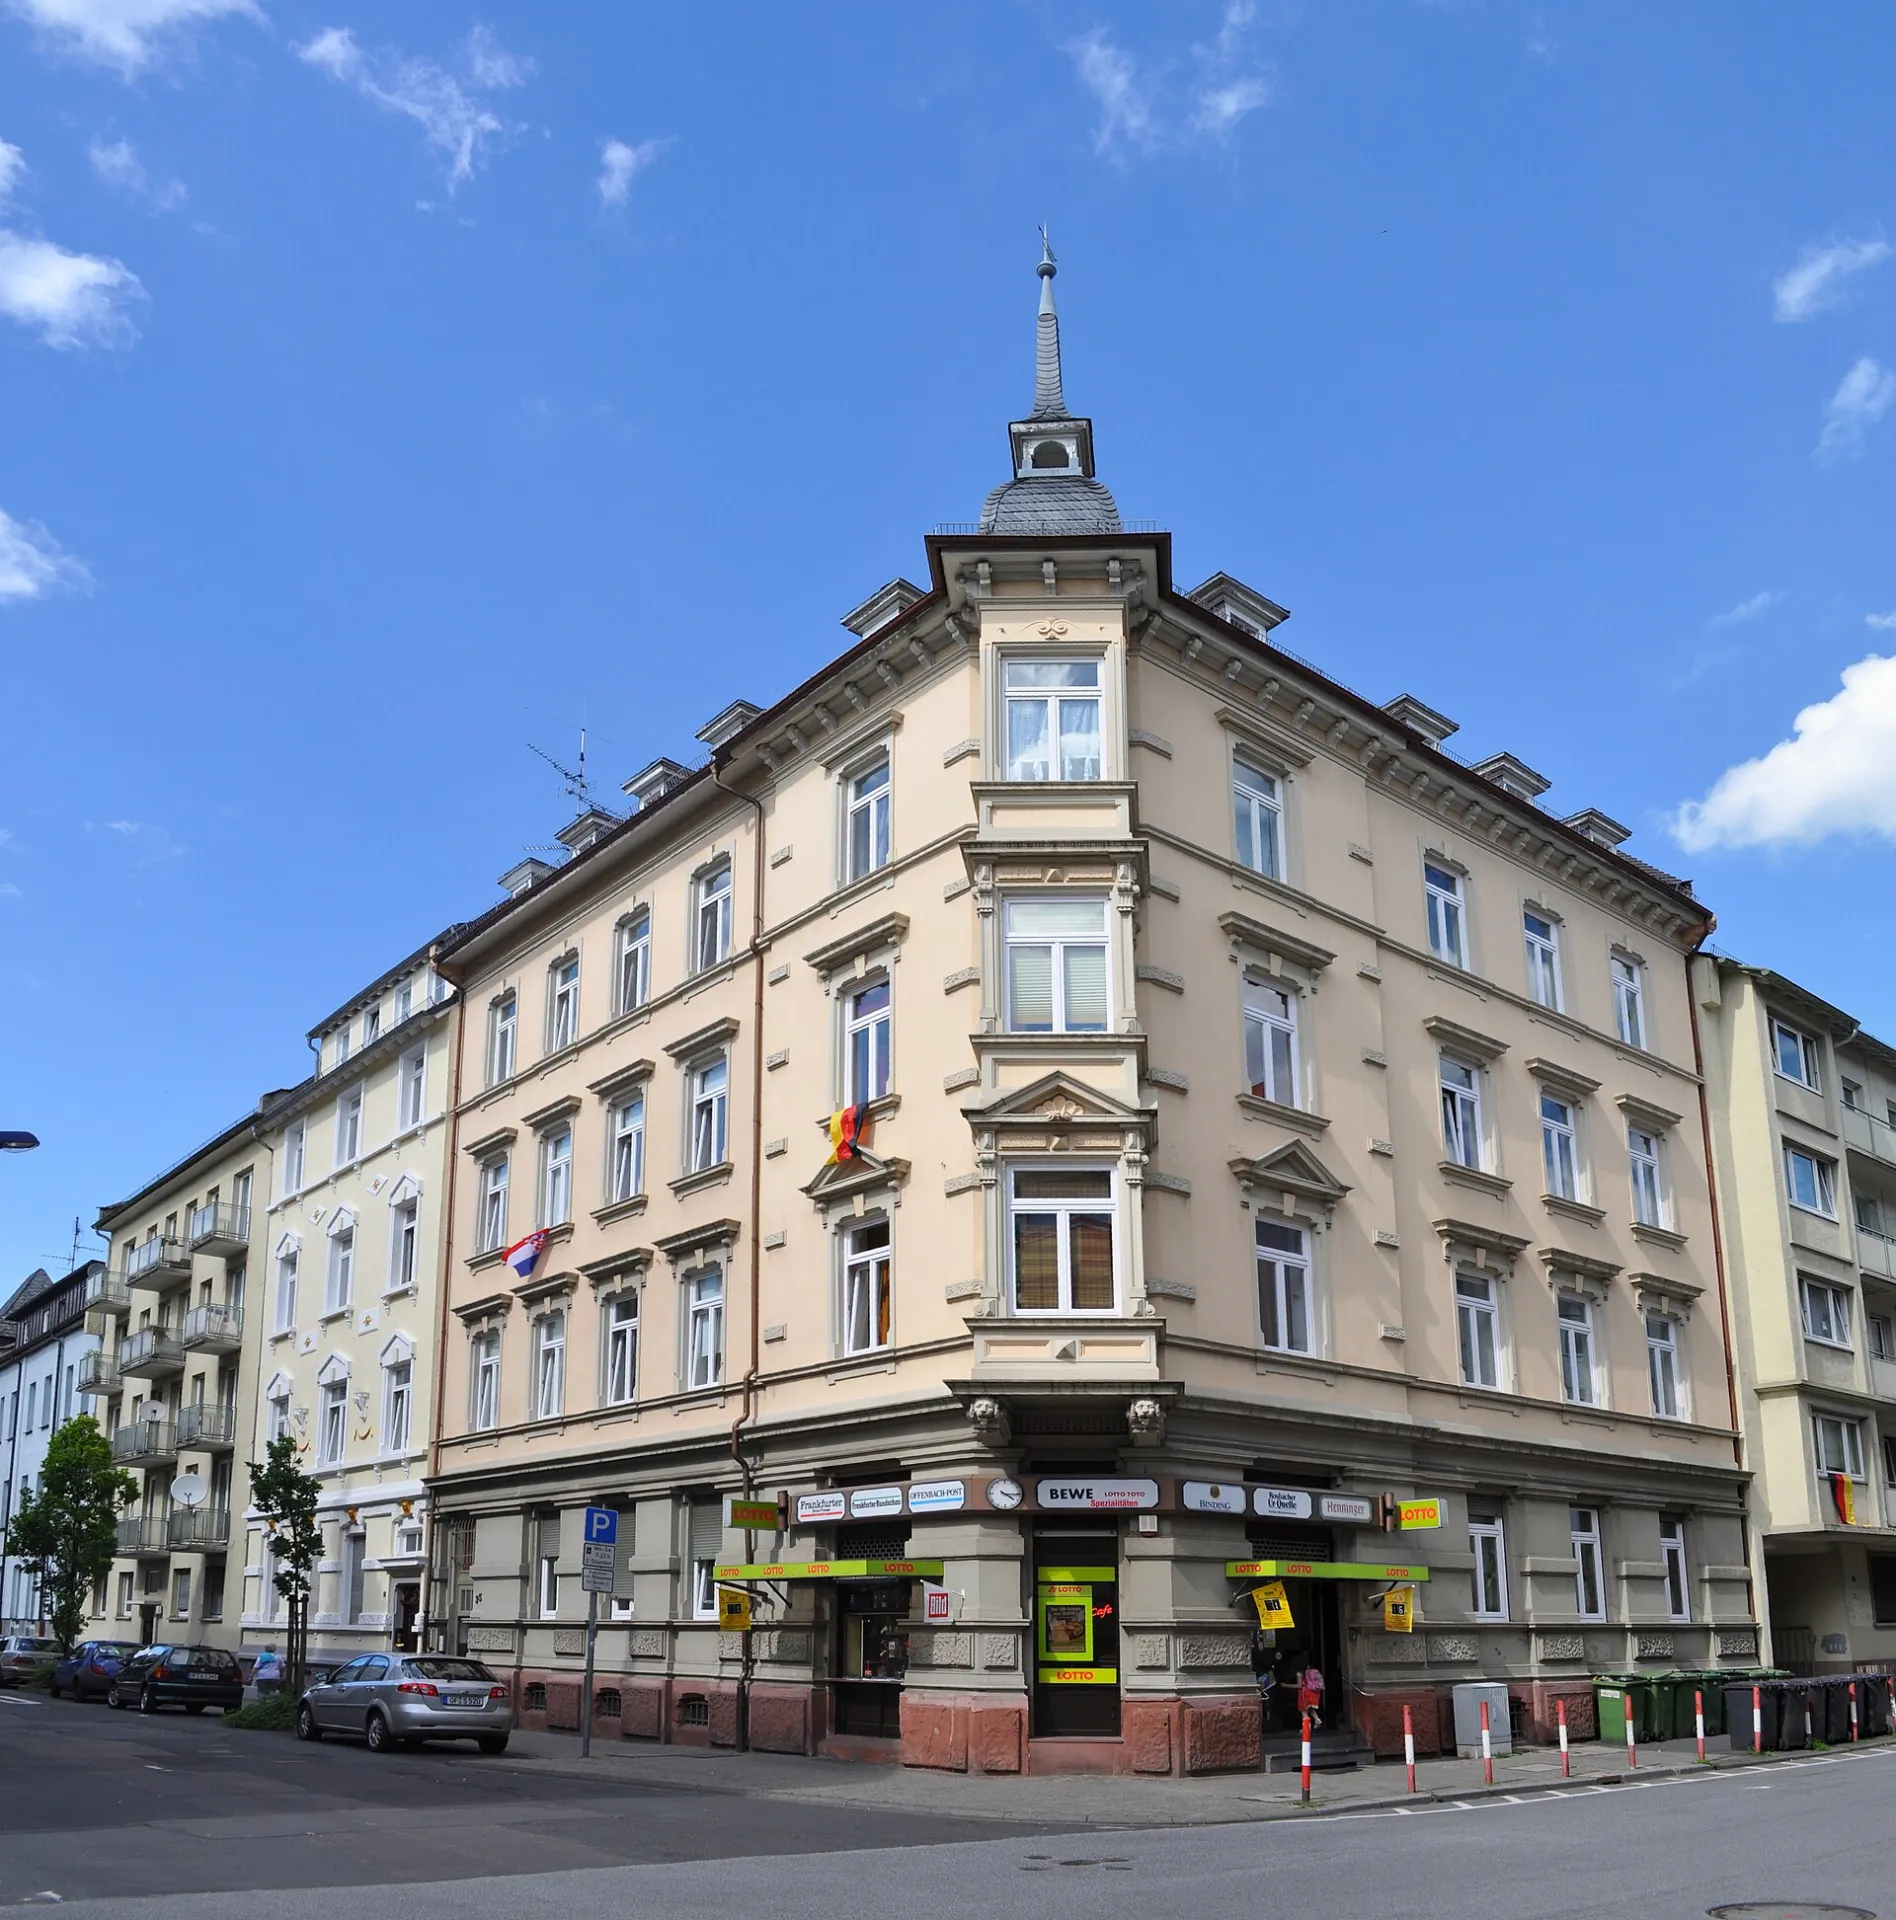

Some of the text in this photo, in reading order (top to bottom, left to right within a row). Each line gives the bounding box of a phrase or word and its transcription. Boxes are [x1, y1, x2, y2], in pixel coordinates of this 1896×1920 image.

[910, 1487, 963, 1500] OFFENBACH-POST
[1049, 1488, 1094, 1500] BEWE
[800, 1499, 843, 1510] Frankfurter
[1090, 1499, 1139, 1508] Spezialitäten
[1199, 1499, 1232, 1510] BINDING
[1326, 1501, 1365, 1516] Henninger
[733, 1506, 776, 1523] LOTTO
[1399, 1507, 1437, 1521] LOTTO
[592, 1512, 610, 1538] P
[720, 1568, 739, 1577] LOTTO
[763, 1566, 784, 1576] LOTTO
[807, 1564, 830, 1574] LOTTO
[884, 1563, 914, 1573] LOTTO
[1235, 1563, 1262, 1574] LOTTO
[1286, 1564, 1312, 1574] LOTTO
[1386, 1567, 1409, 1578] LOTTO
[1056, 1671, 1094, 1680] LOTTO
